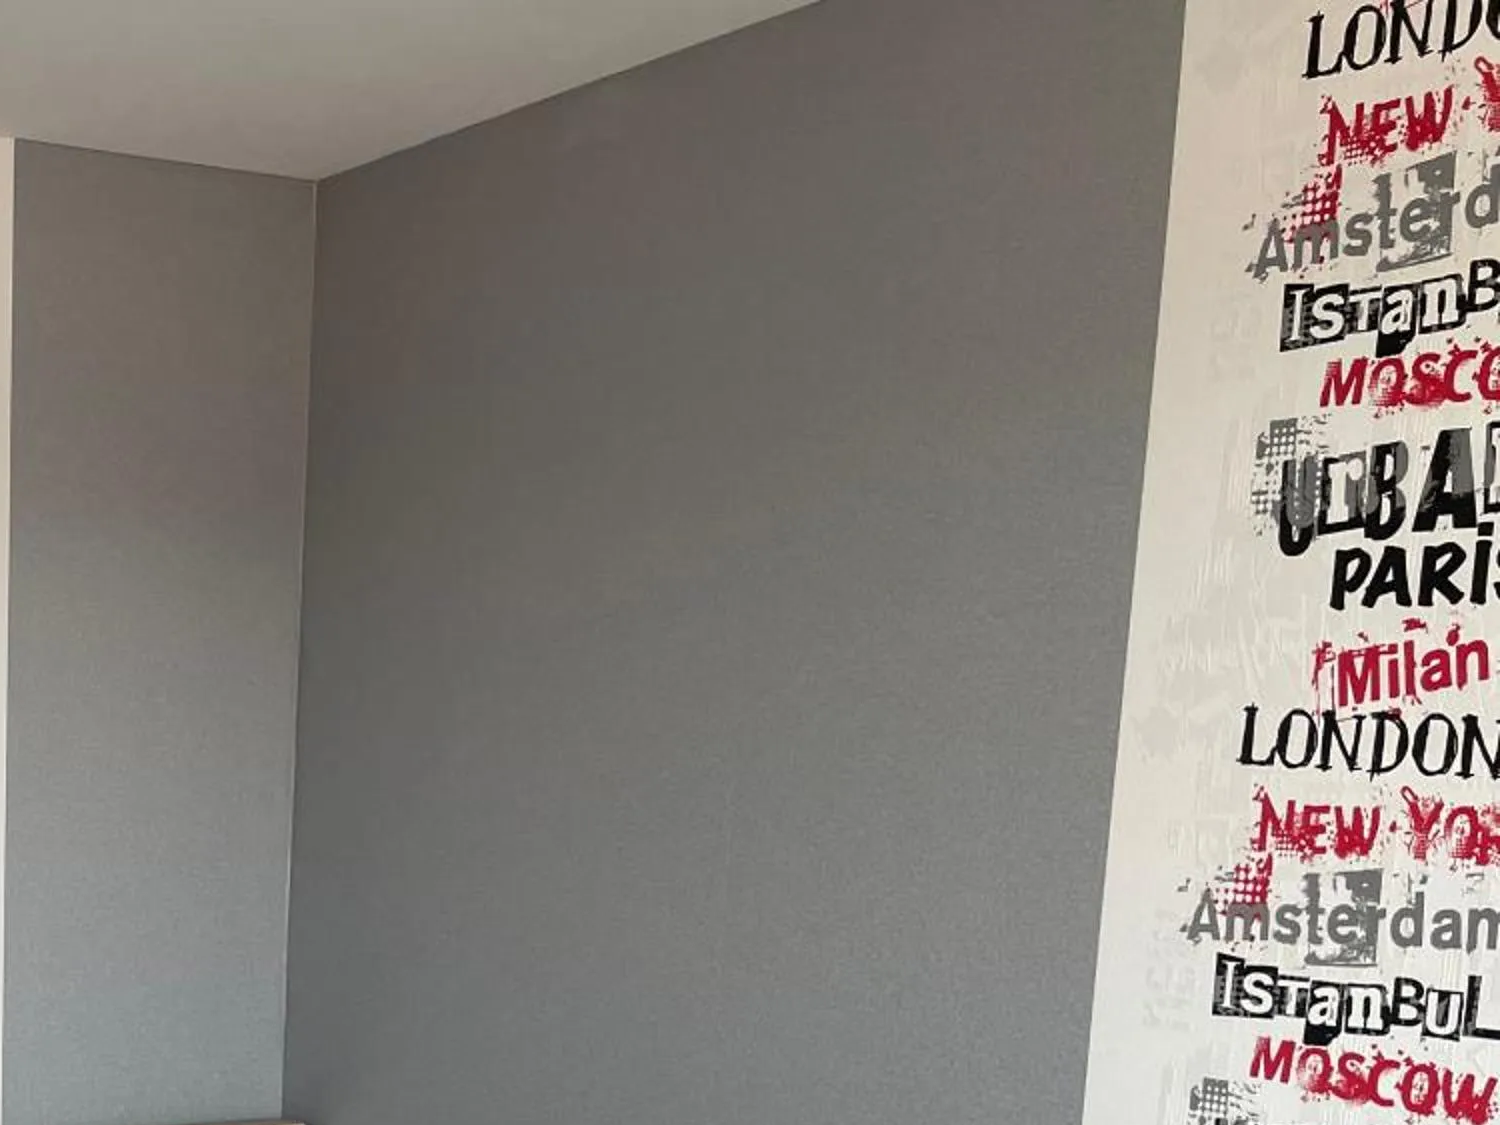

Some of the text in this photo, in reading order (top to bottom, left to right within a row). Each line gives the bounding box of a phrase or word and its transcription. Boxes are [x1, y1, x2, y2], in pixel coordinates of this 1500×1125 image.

[1302, 0, 1500, 78] LOND
[1320, 85, 1454, 167] NEW
[1338, 638, 1490, 707] Milan
[1237, 703, 1500, 780] LONDON
[1253, 788, 1381, 859] NEW
[1250, 1036, 1498, 1125] MOSCOW
